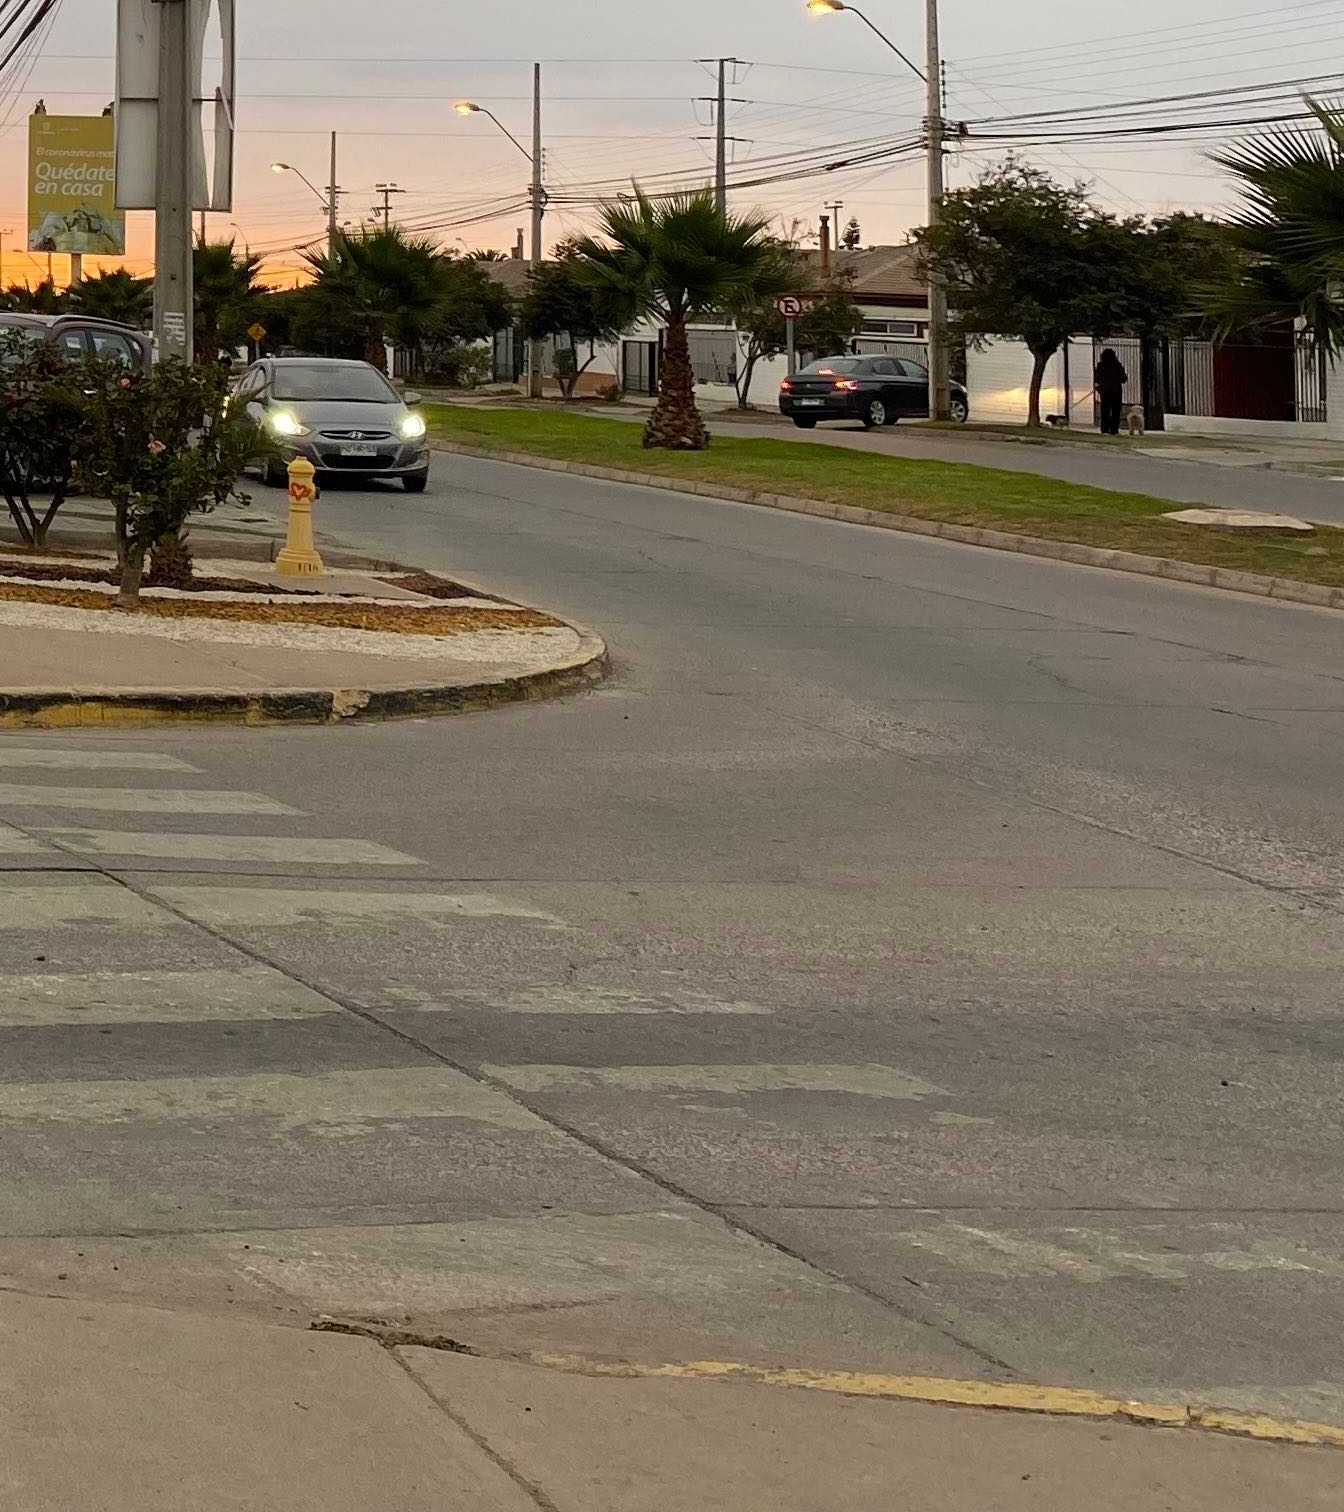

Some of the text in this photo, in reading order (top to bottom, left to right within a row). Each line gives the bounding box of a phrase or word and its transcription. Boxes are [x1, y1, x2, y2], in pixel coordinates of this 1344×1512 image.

[36, 162, 114, 181] Quédate
[35, 182, 104, 196] en casa
